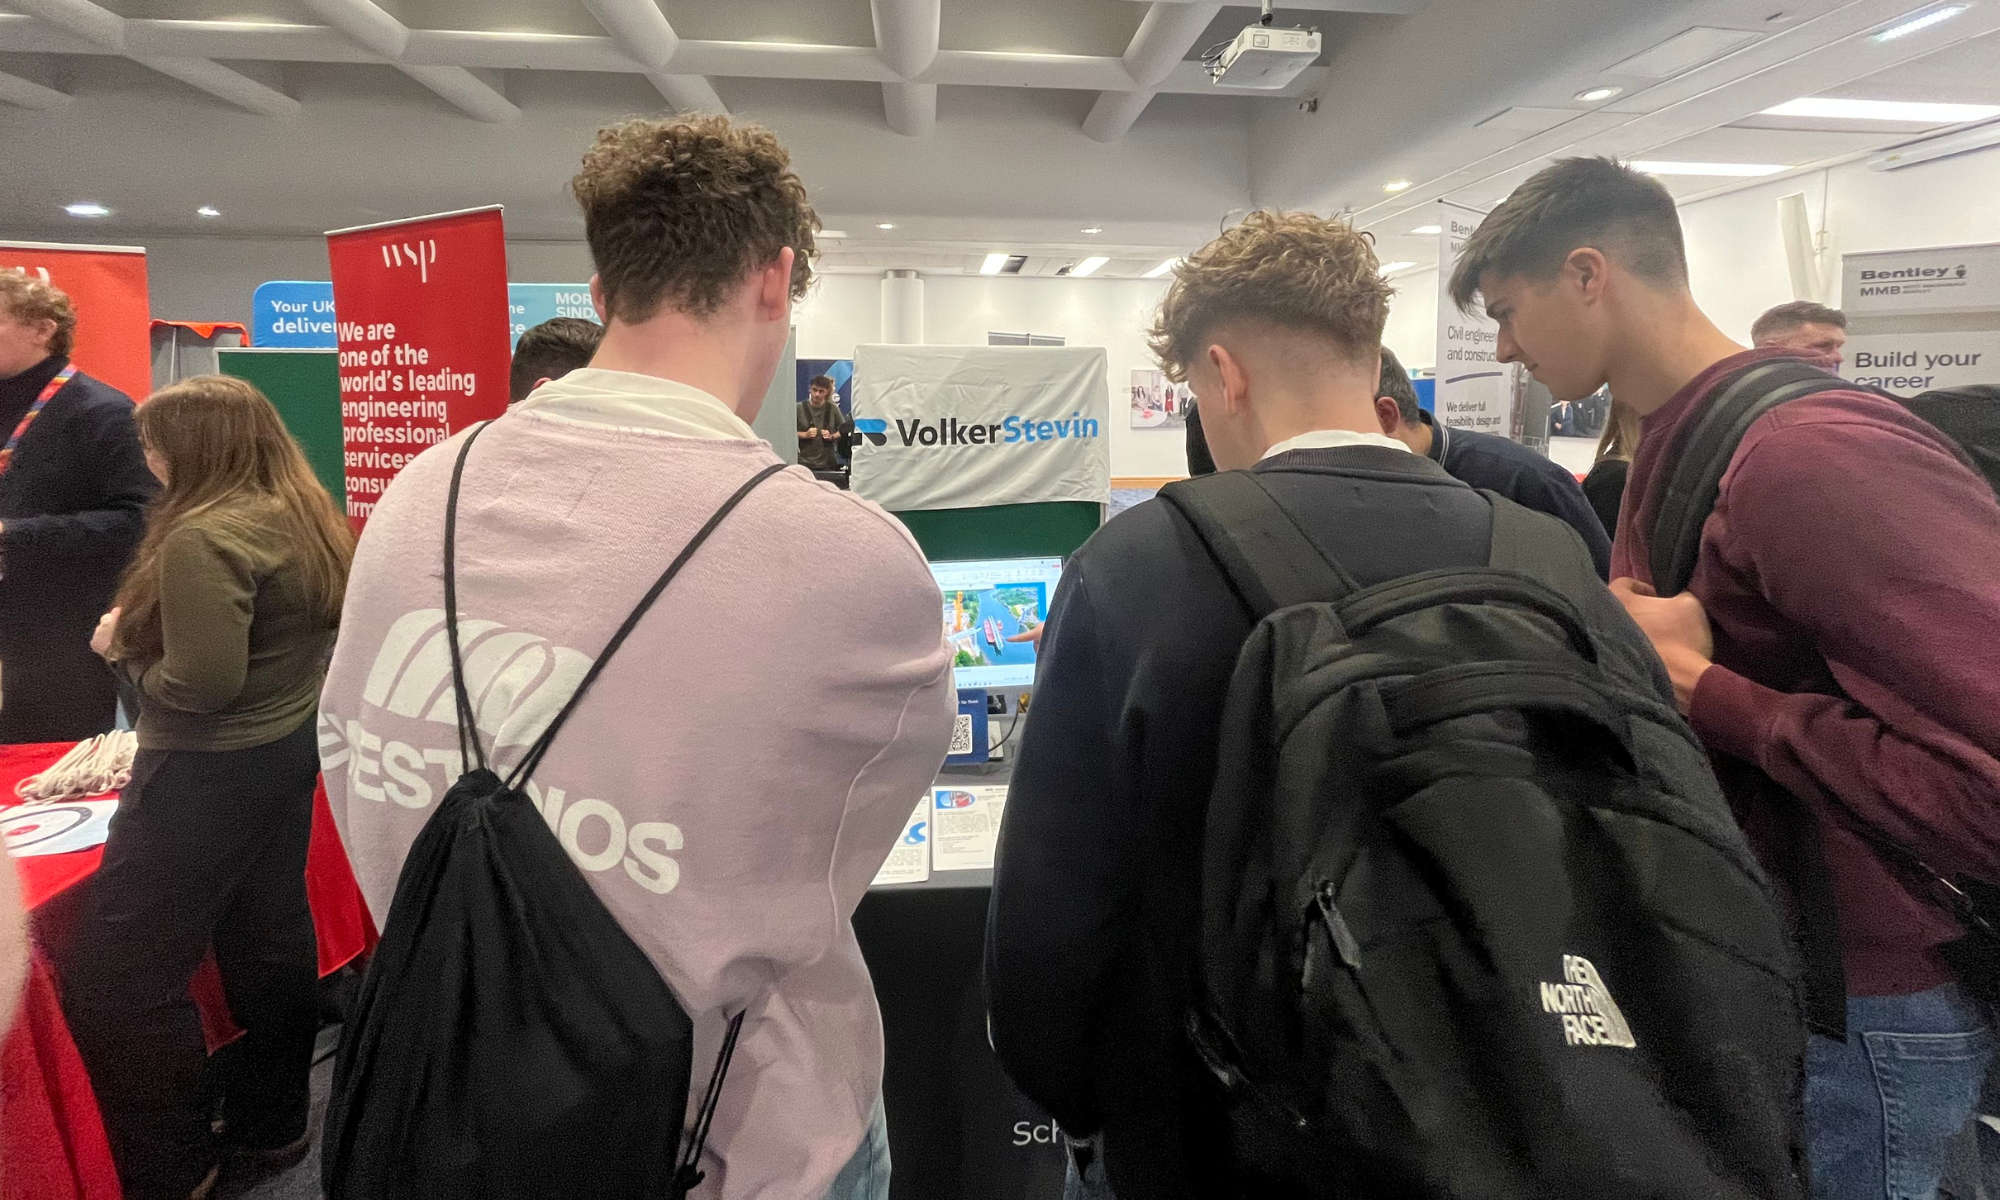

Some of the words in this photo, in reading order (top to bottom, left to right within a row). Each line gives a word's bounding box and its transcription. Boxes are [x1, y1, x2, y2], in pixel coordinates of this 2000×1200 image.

[1860, 267, 1949, 280] Bentley
[1860, 285, 1901, 297] MMB
[271, 300, 308, 313] Your
[312, 301, 335, 313] UK
[338, 321, 364, 342] We
[367, 323, 396, 341] are
[1447, 325, 1463, 341] Civil
[340, 350, 367, 367] one
[371, 344, 390, 366] of
[395, 343, 429, 365] the
[1447, 347, 1463, 361] and
[1855, 351, 1917, 368] Build
[1924, 353, 1982, 371] your
[340, 369, 403, 392] world's
[408, 367, 476, 396] leading
[342, 394, 448, 423] engineering
[344, 421, 450, 445] professional
[897, 411, 1098, 447] VolkerStevin
[1540, 981, 1597, 1014] NORTH
[1562, 1014, 1611, 1046] FACE
